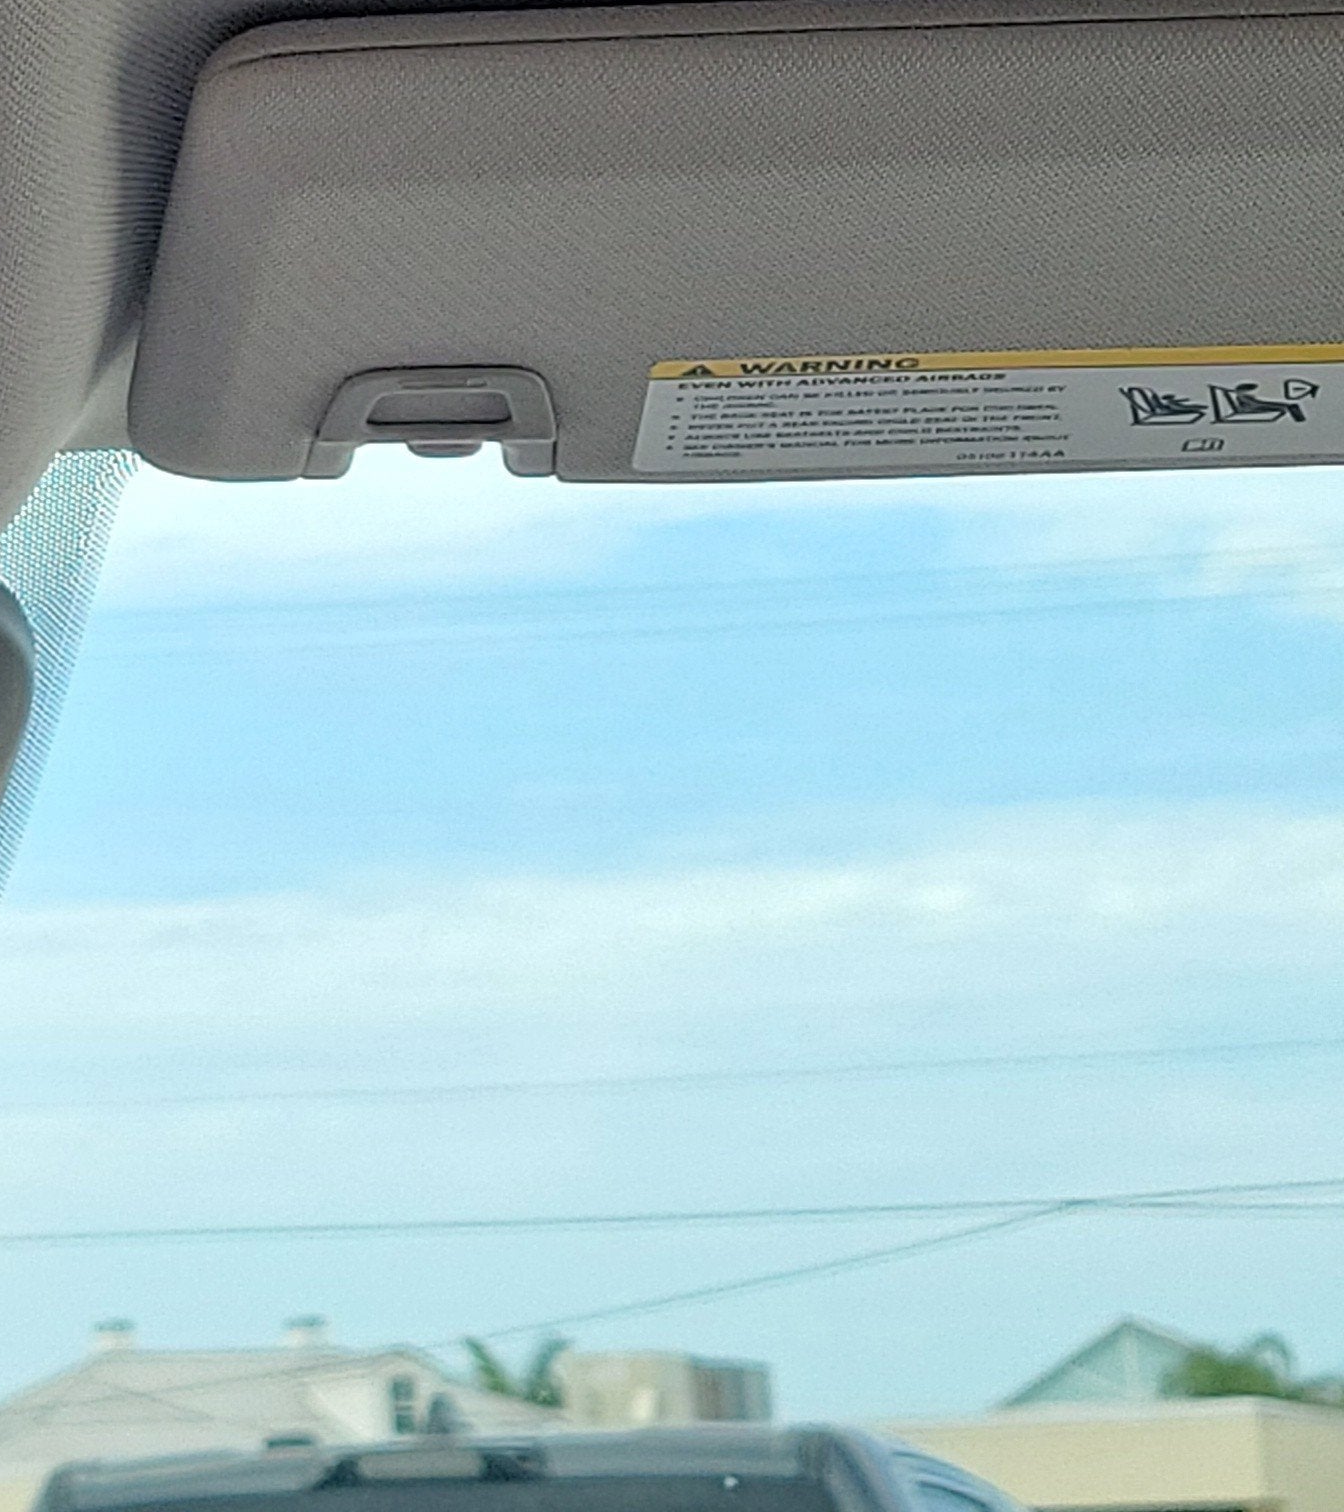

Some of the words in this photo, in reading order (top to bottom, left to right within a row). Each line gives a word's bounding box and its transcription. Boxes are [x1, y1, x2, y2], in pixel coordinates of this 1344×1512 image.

[739, 358, 920, 375] WARNING
[677, 381, 732, 390] EVEN
[737, 380, 792, 389] WITH
[796, 375, 911, 387] ADVANCED
[914, 373, 1007, 383] AIRBAGS
